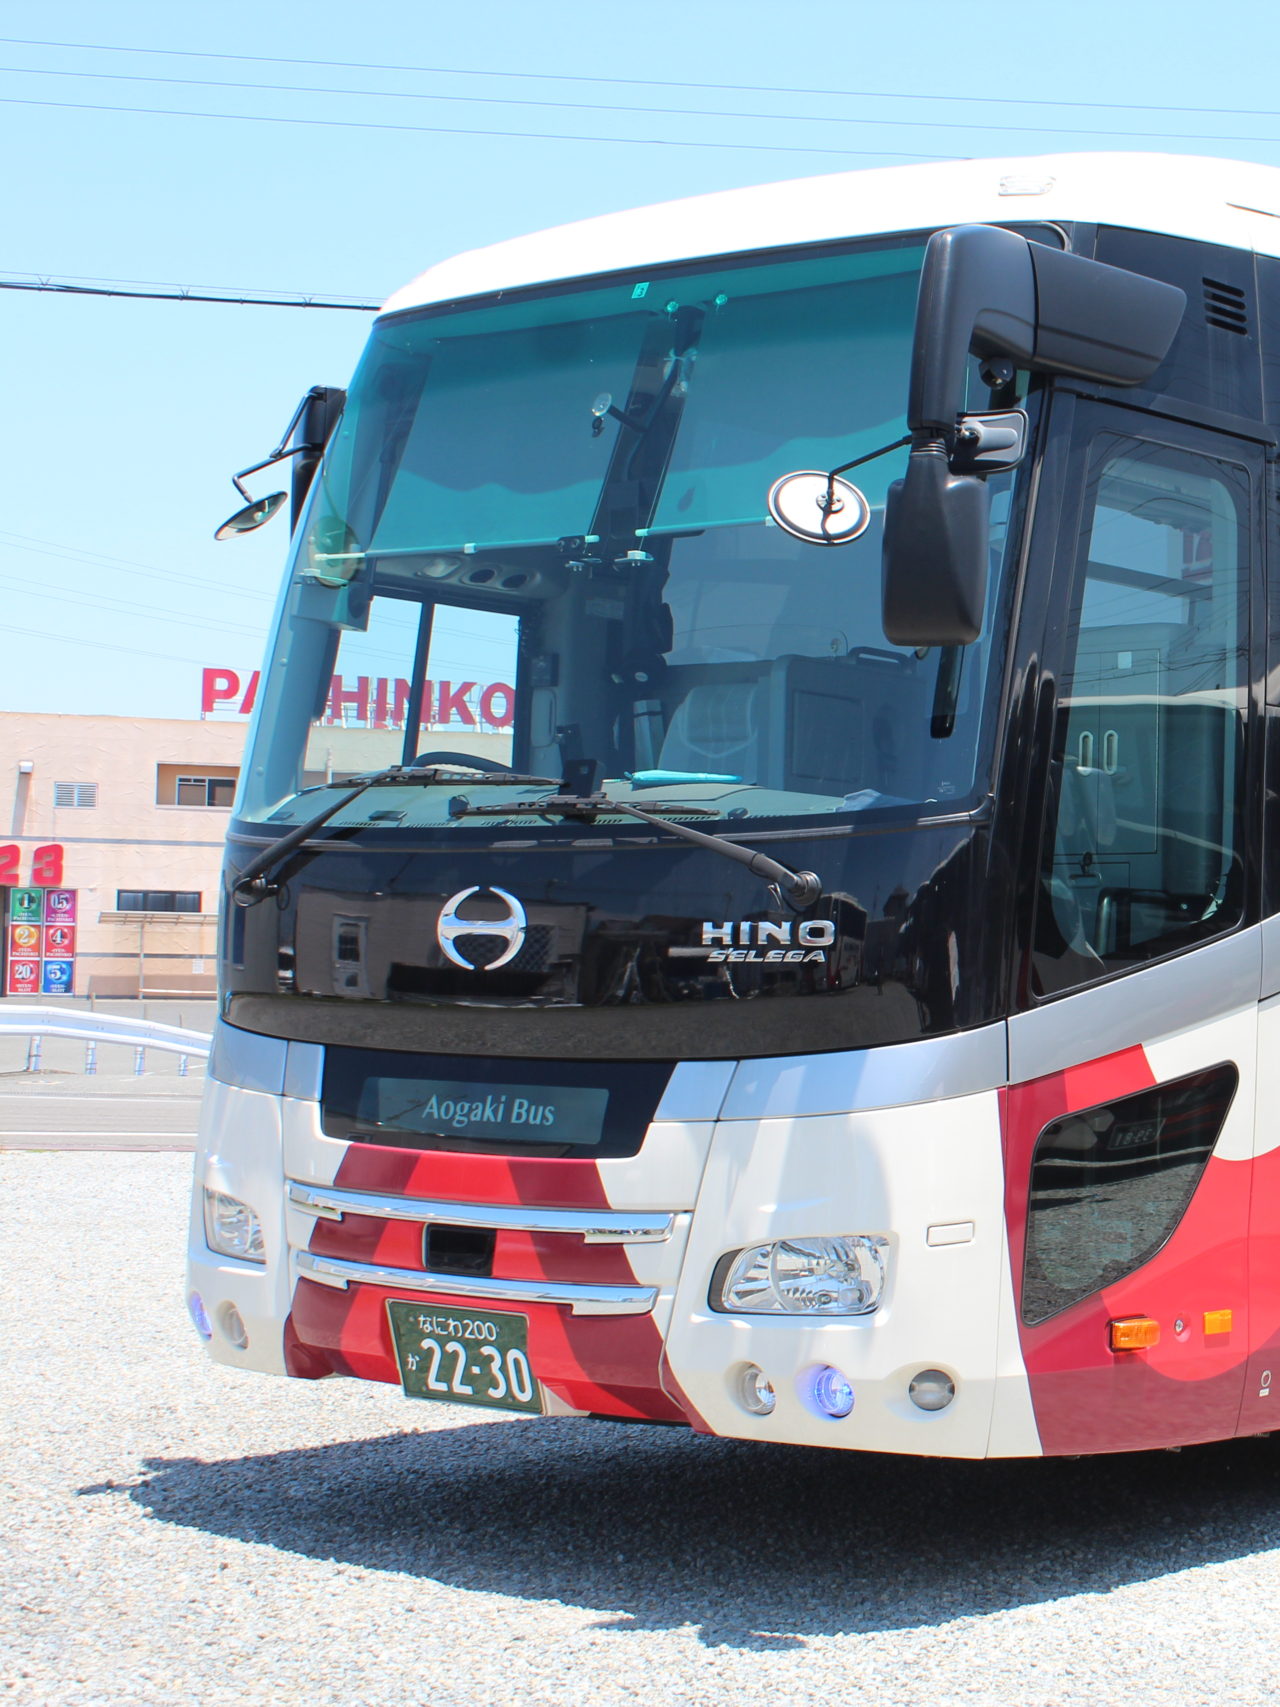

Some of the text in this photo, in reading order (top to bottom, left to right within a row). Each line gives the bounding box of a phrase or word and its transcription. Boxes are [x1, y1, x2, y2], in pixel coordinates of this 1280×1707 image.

[201, 667, 515, 728] PHINKO
[51, 928, 64, 944] 4
[702, 920, 835, 946] HINO
[707, 948, 826, 962] SELEGA
[14, 964, 31, 979] 20
[47, 964, 62, 980] 5
[421, 1094, 556, 1128] Aogaki Bus
[406, 1337, 533, 1403] か 22-30
